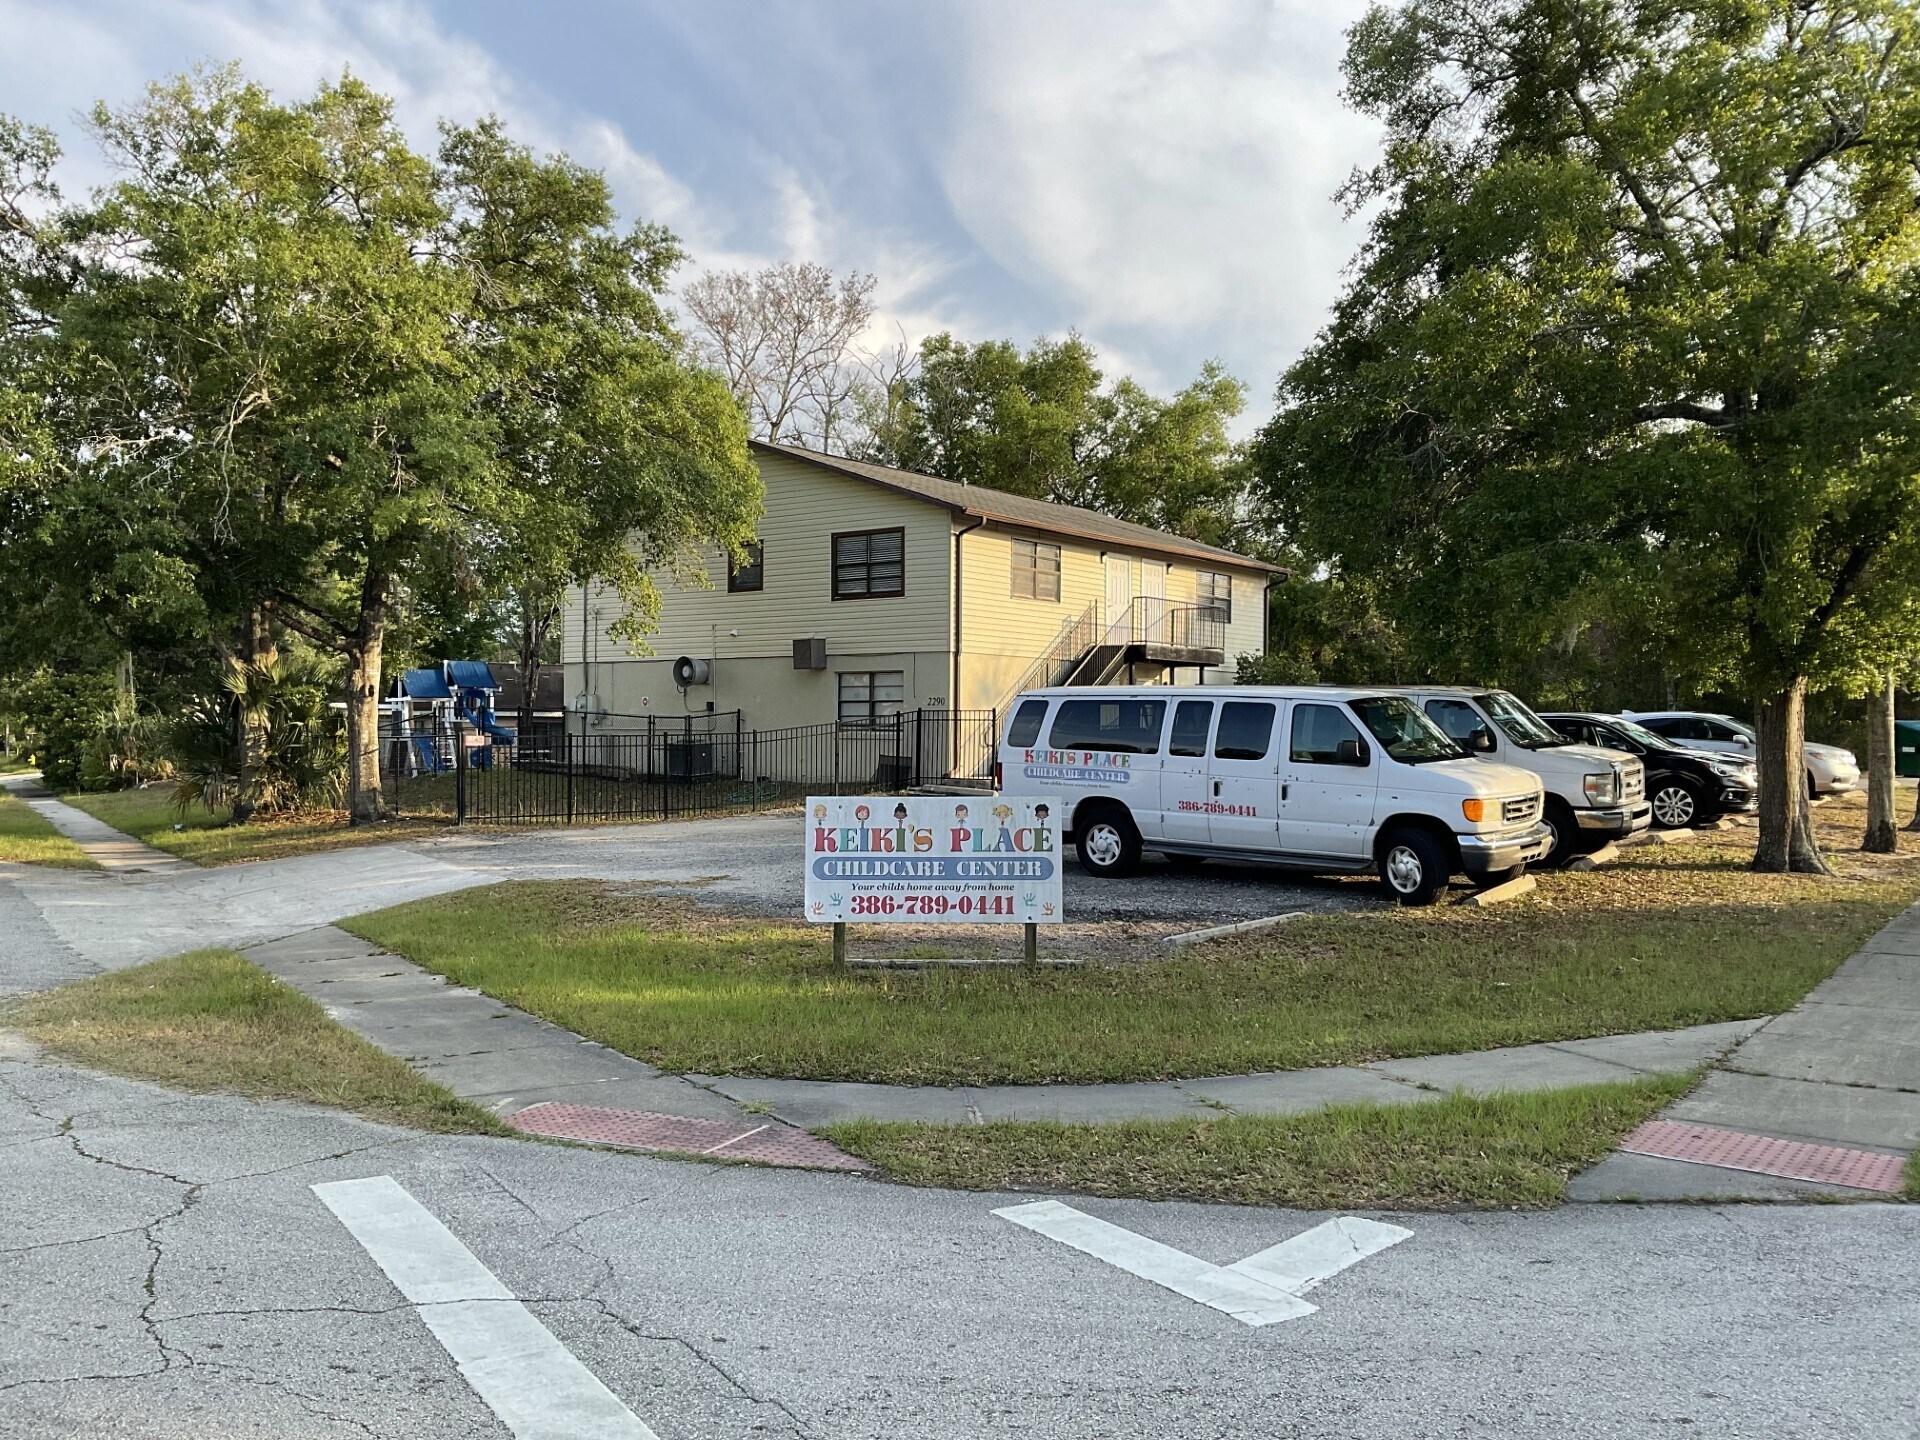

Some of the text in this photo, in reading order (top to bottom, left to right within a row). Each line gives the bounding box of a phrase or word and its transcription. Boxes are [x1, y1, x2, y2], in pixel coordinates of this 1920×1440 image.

[927, 697, 945, 706] 2290
[1024, 749, 1131, 768] KEIKI'S PLACE
[1027, 766, 1125, 782] CHILDCARE CENTER
[1178, 800, 1257, 817] 386-789-0441
[814, 824, 1054, 853] KEIKI'S PLACE
[823, 860, 1042, 876] CHILDCARE CENTER
[851, 883, 1014, 893] Your childs home away from home
[850, 895, 1014, 915] 386-789-0441
